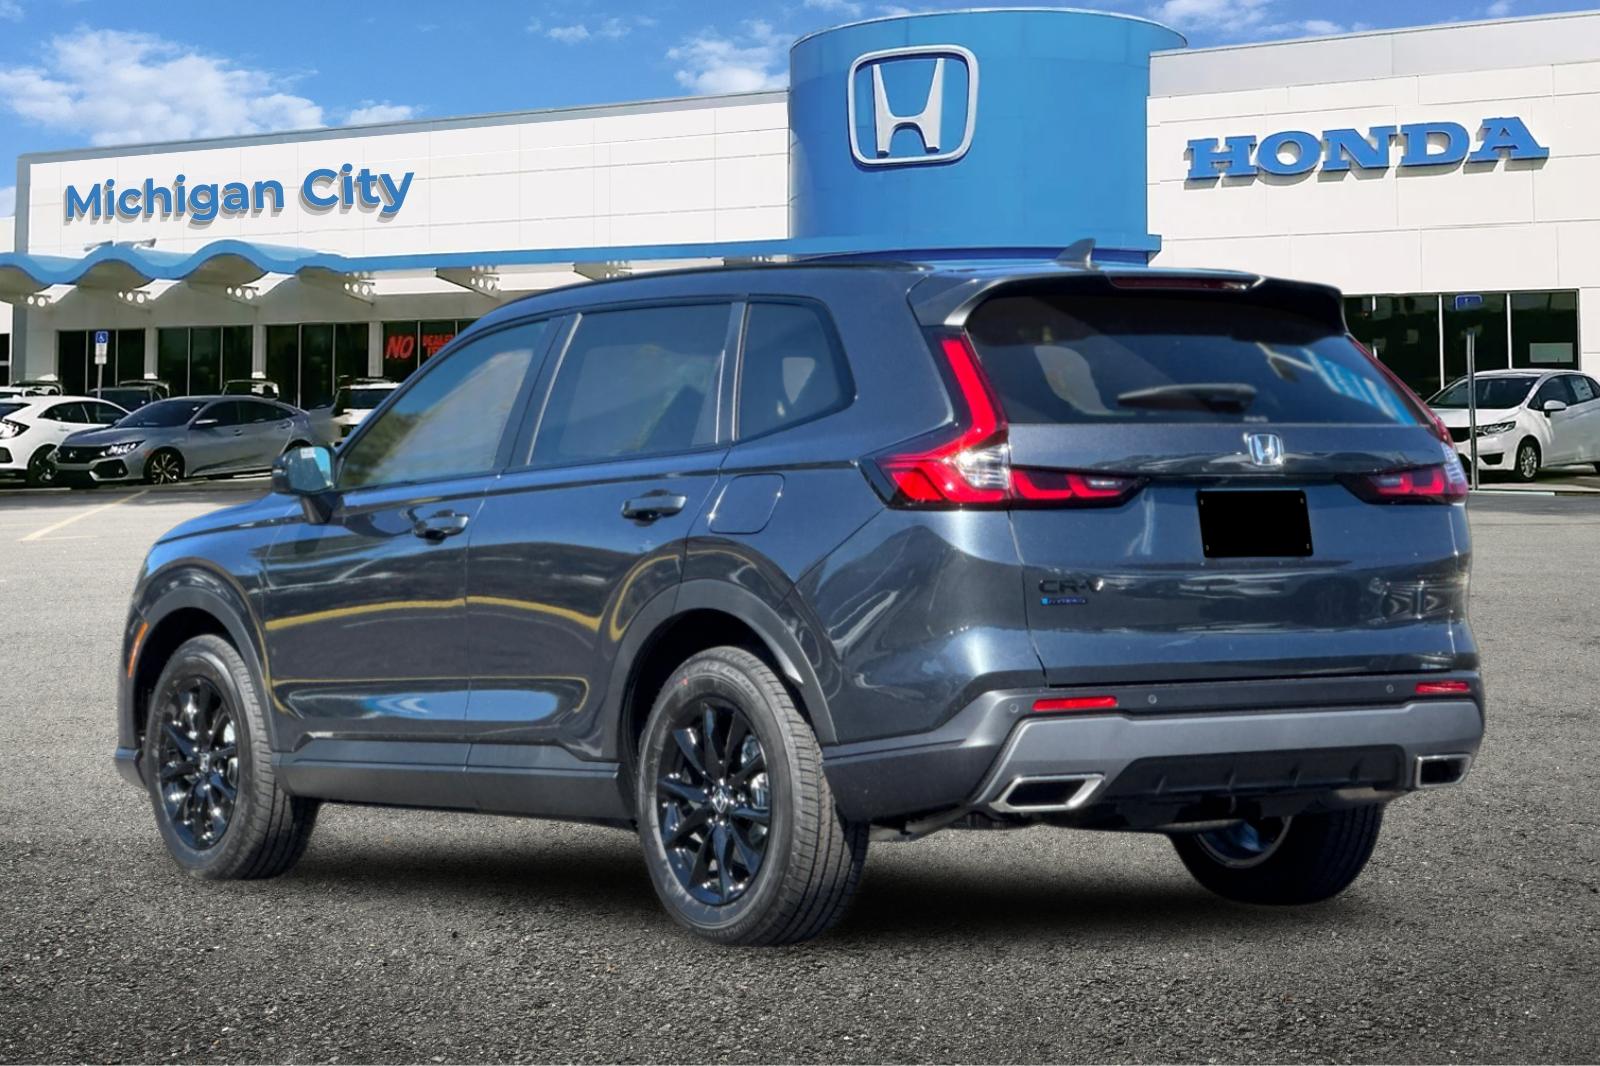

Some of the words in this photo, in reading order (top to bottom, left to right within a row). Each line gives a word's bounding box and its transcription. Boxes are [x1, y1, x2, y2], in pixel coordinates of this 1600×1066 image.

[1186, 115, 1549, 183] HONDA
[65, 174, 285, 222] Michigan
[303, 163, 415, 215] City
[385, 335, 414, 359] NO
